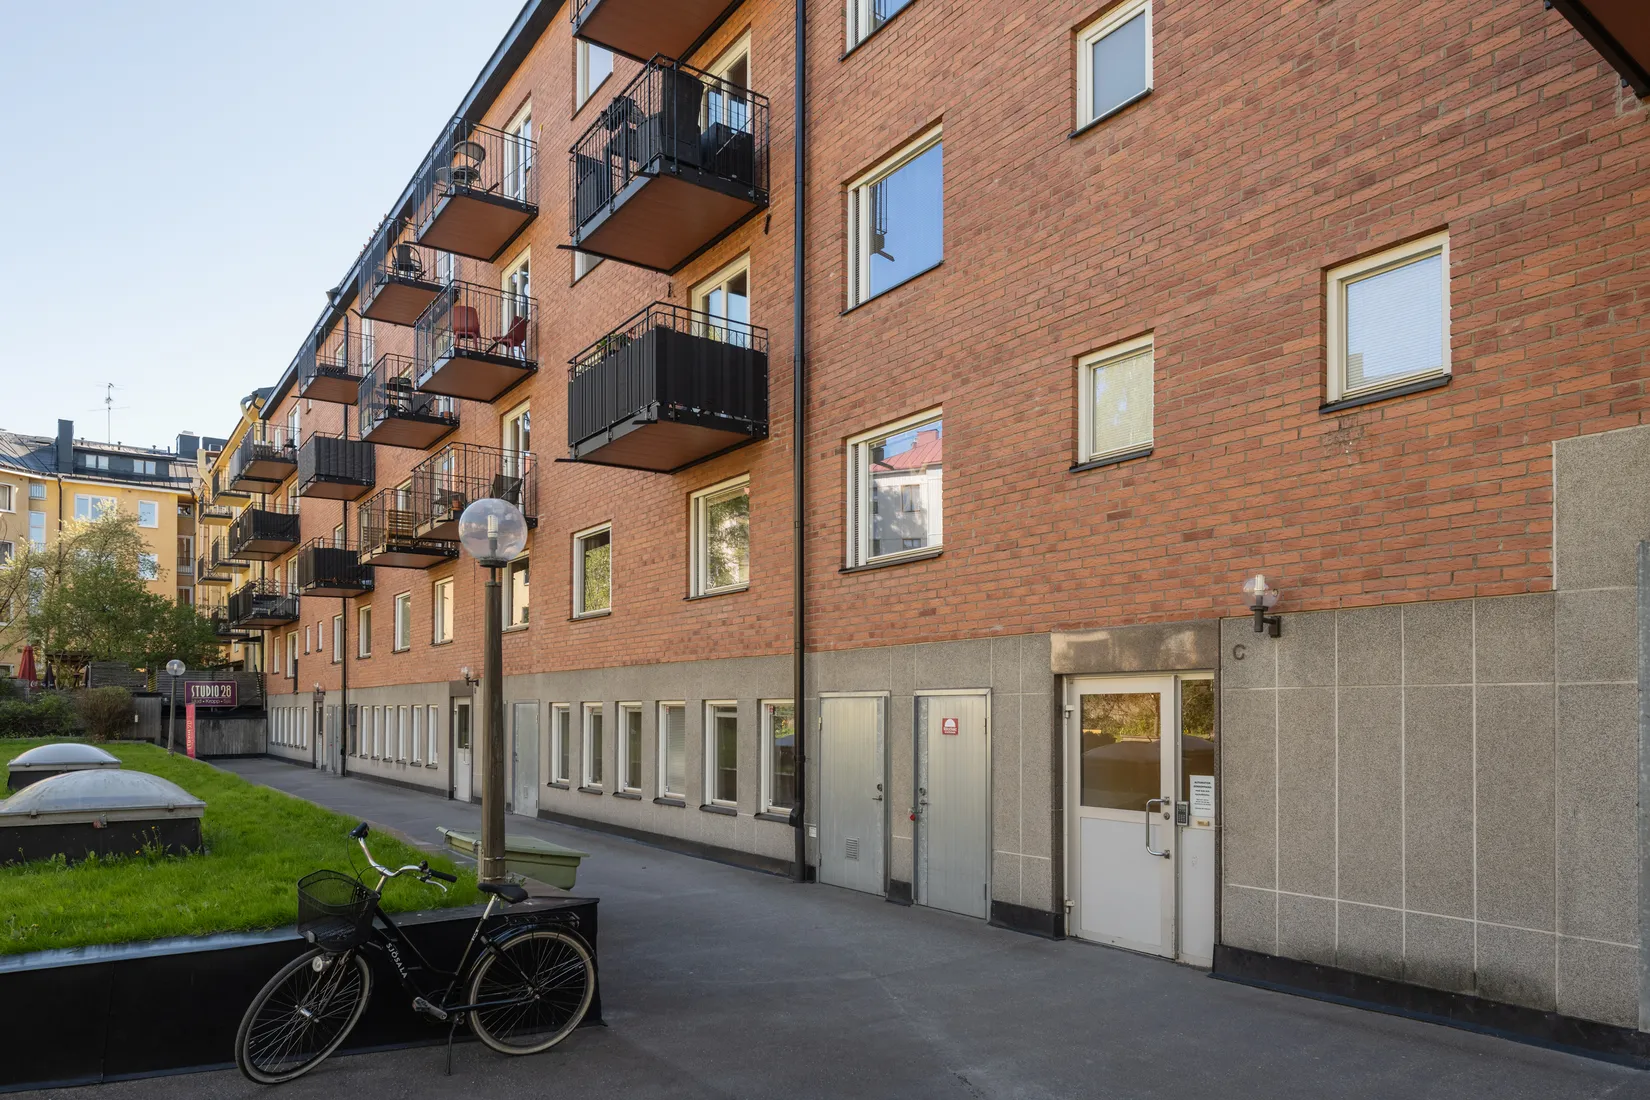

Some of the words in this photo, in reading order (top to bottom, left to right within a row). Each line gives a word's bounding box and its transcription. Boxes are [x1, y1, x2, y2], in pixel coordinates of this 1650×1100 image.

[1233, 644, 1246, 660] C
[191, 684, 220, 698] STUDIO
[220, 684, 232, 698] 28
[385, 942, 408, 979] SJÖSALA
